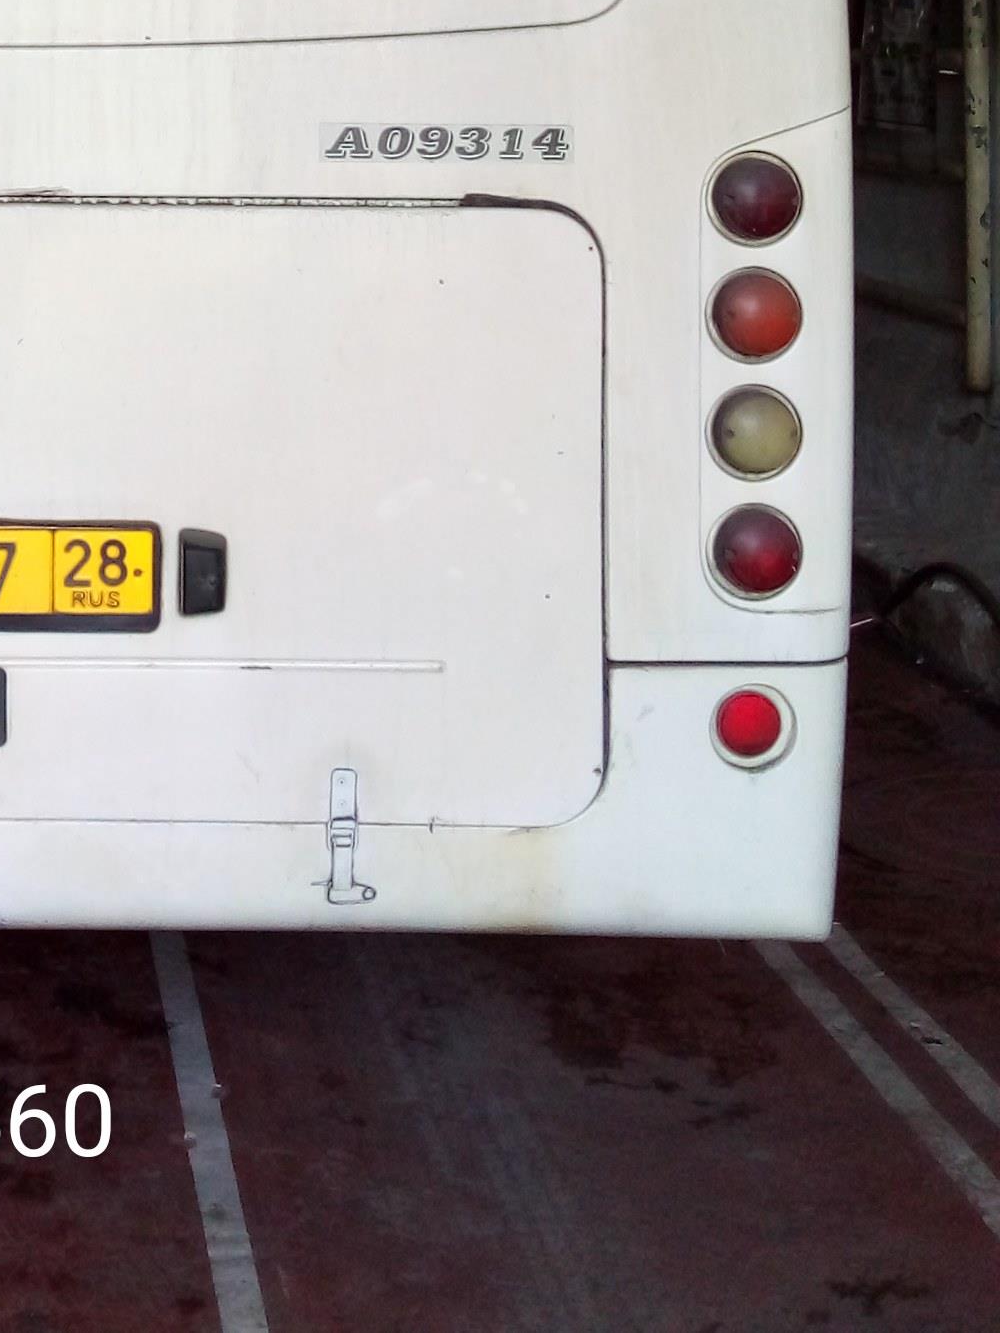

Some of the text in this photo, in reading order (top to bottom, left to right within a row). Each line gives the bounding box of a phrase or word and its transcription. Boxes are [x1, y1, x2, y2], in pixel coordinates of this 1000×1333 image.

[325, 126, 569, 161] A09314
[63, 539, 128, 588] 28
[72, 590, 120, 608] RUS
